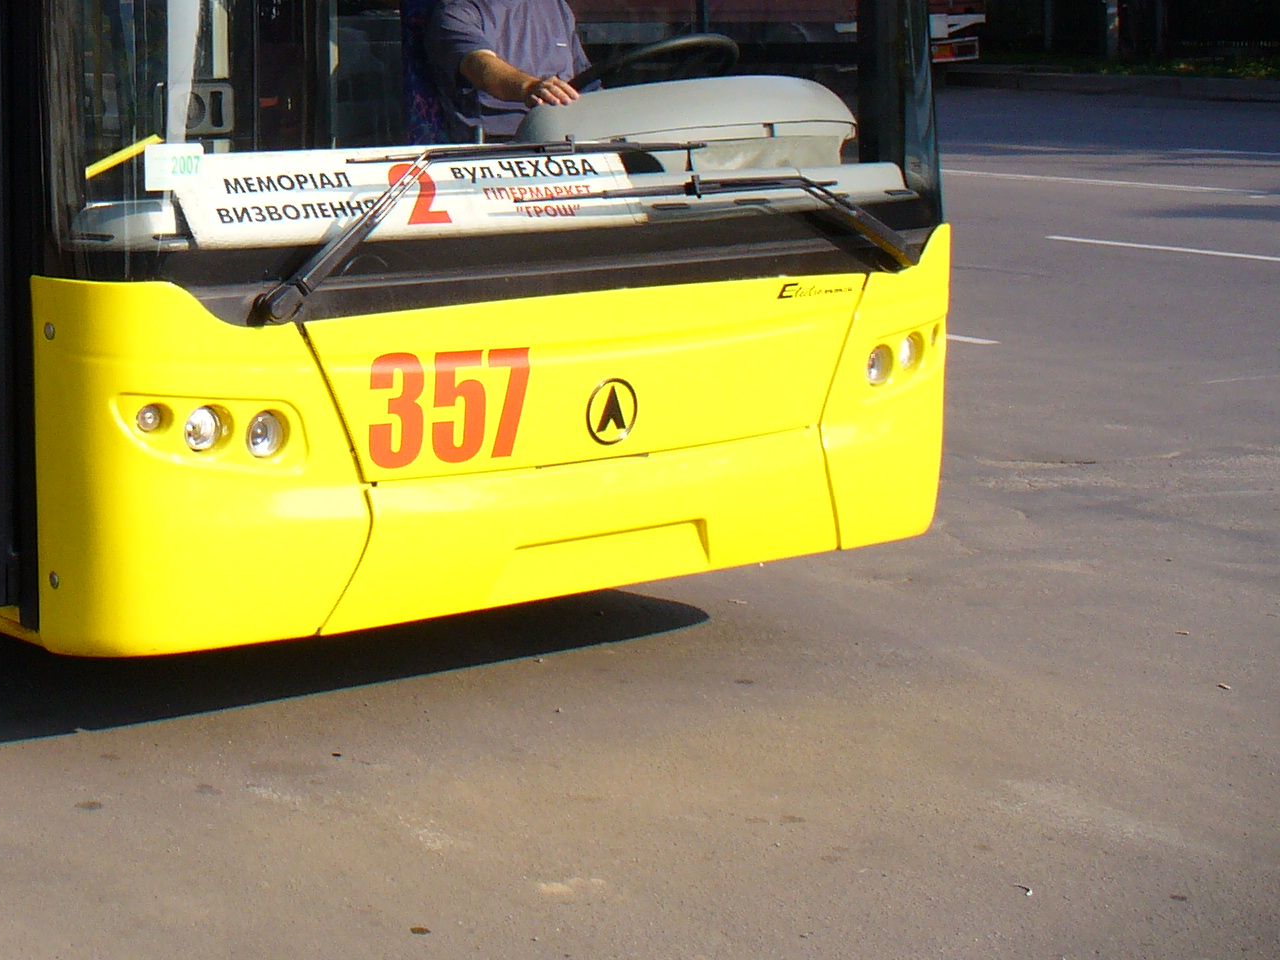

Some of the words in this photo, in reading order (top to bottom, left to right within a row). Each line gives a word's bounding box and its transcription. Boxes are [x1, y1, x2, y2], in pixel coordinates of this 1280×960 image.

[171, 155, 201, 174] 2007
[223, 172, 351, 194] МЕМОРІАЛ
[388, 163, 453, 225] 2
[482, 185, 591, 201] ГІПЕРМАРКЕТ
[369, 346, 530, 469] 357
